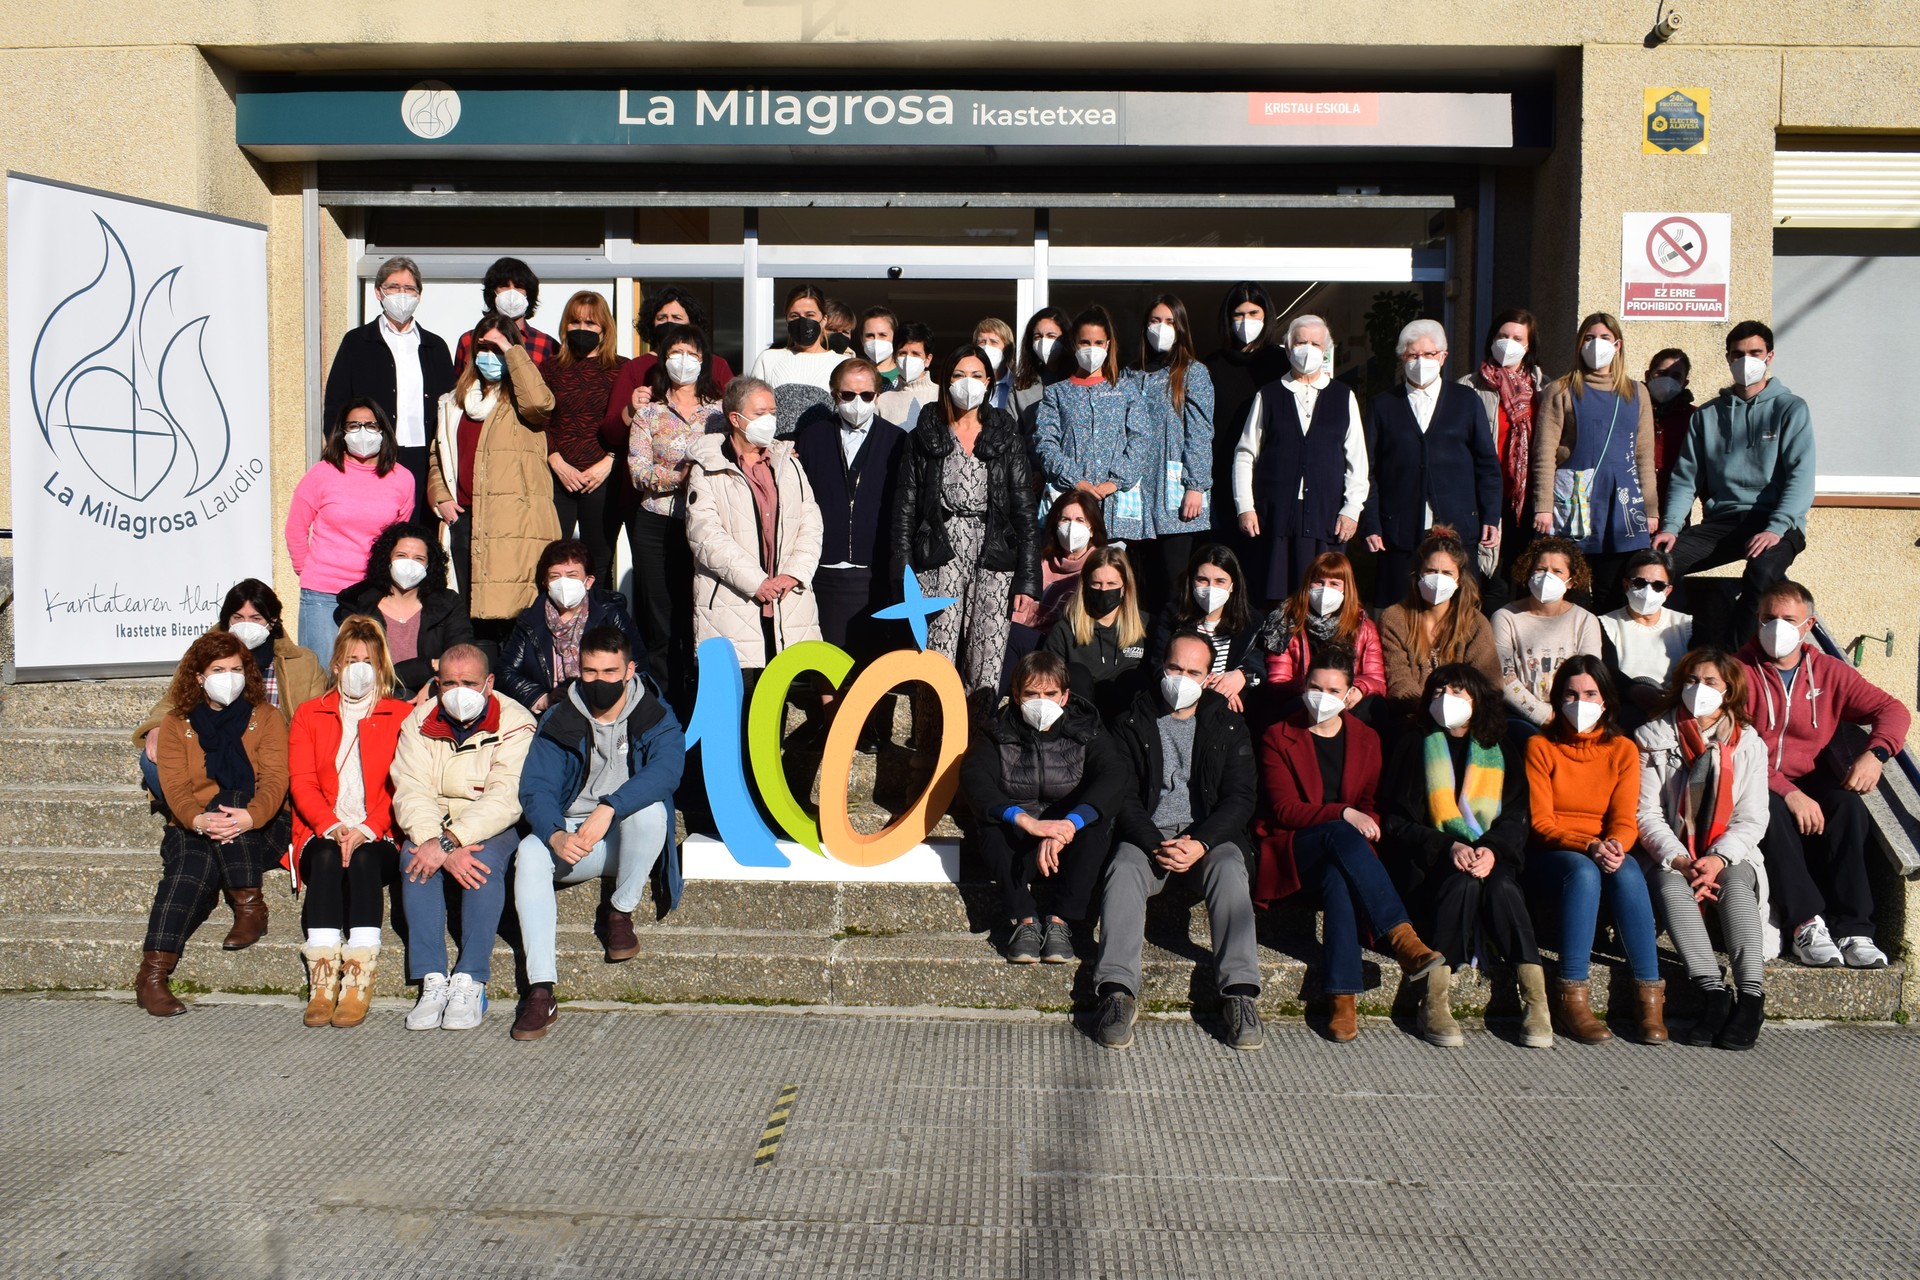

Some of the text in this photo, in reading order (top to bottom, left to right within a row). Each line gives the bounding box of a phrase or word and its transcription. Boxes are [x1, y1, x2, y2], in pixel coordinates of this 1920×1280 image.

[618, 89, 1117, 135] La Milagrosa ikastetxea
[1264, 102, 1361, 116] KRISTAU ESKOLA
[1654, 288, 1696, 298] EZ ERRE
[1626, 301, 1723, 312] PROHIBIDO FUMAR
[43, 458, 264, 540] La Milagrosa Laudio
[44, 583, 172, 622] Karitatearen
[116, 623, 167, 639] Ikastetxe
